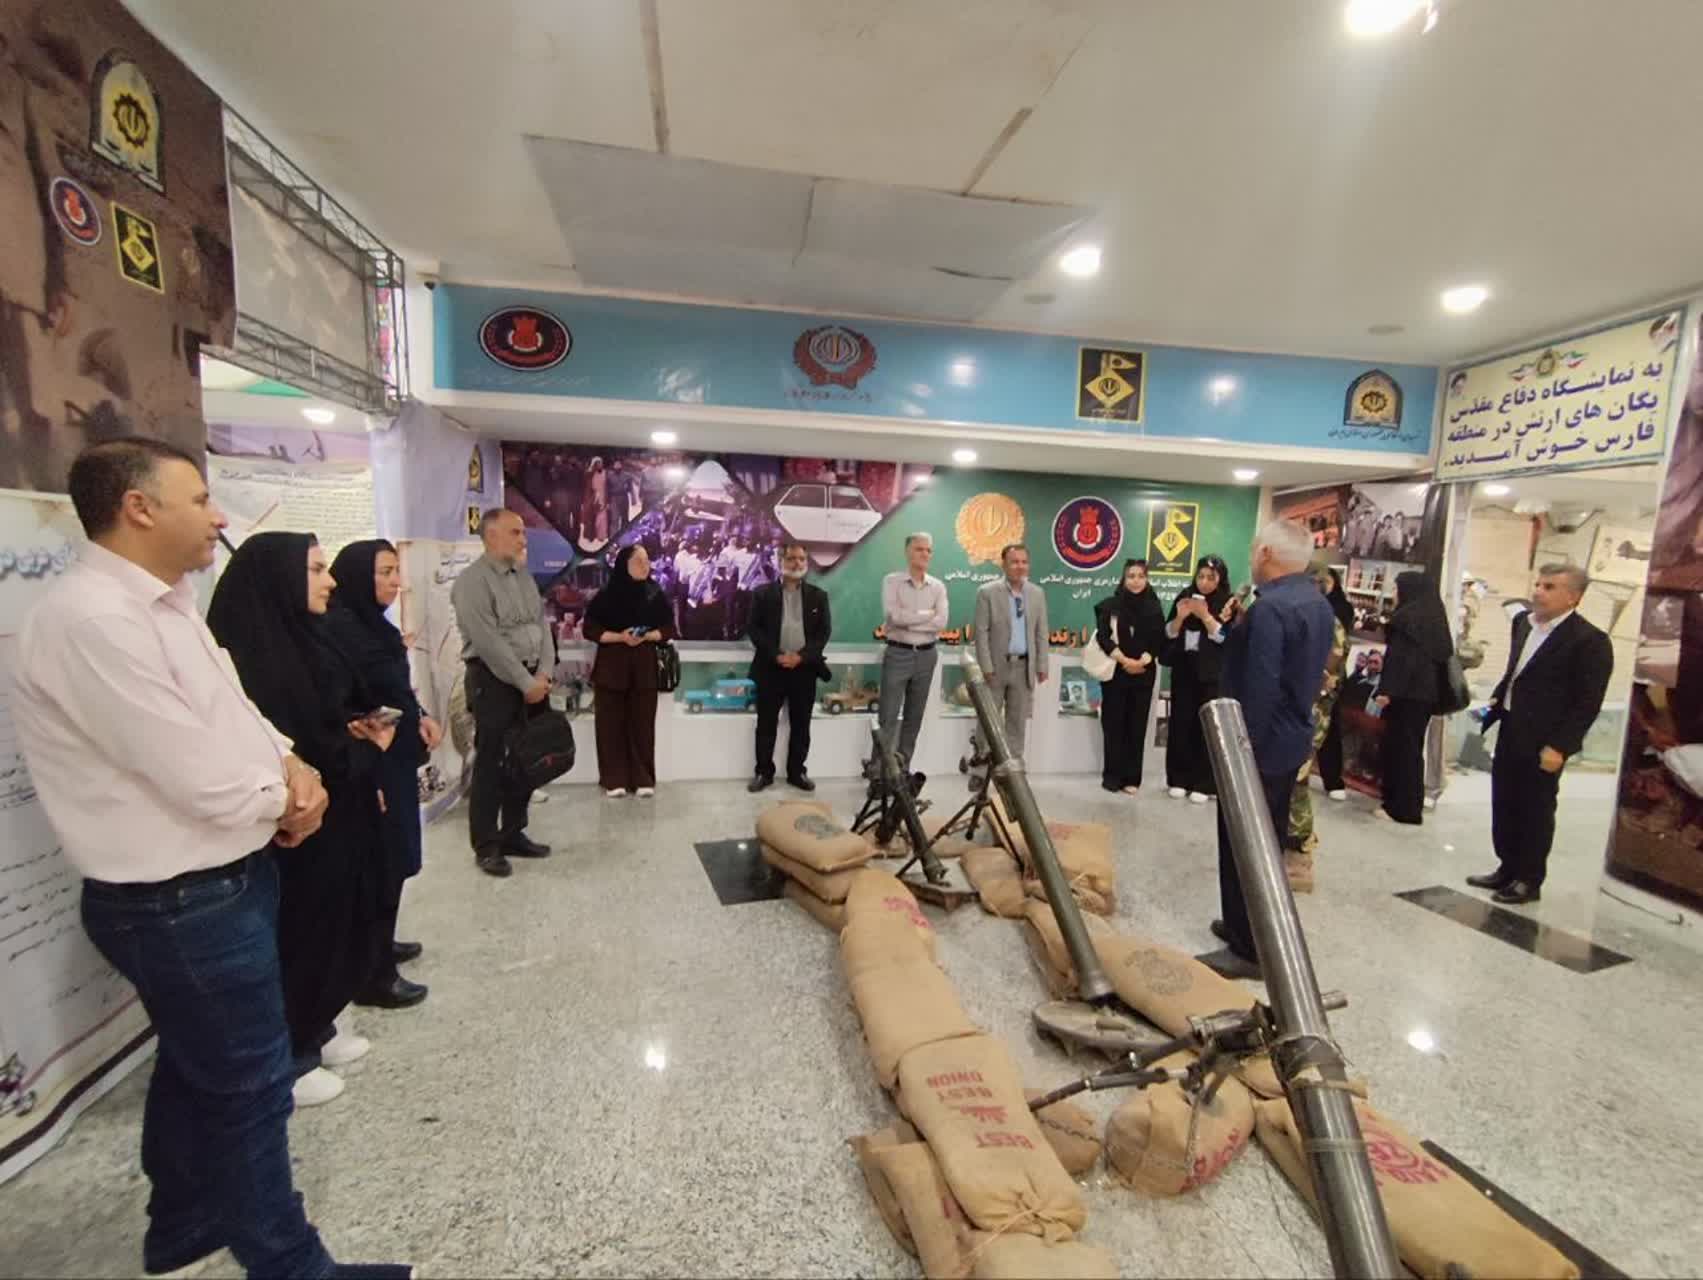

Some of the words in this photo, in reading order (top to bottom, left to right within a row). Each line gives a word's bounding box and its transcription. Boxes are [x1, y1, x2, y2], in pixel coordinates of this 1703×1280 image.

[1642, 361, 1663, 381] به
[1450, 397, 1493, 423] مقدس
[1498, 386, 1536, 414] دفاع
[1565, 400, 1602, 428] های
[1448, 424, 1487, 442] منطقه
[1492, 420, 1511, 441] در
[1516, 408, 1560, 436] ارتش
[1594, 418, 1655, 453] فارس
[1526, 432, 1588, 462] خوش
